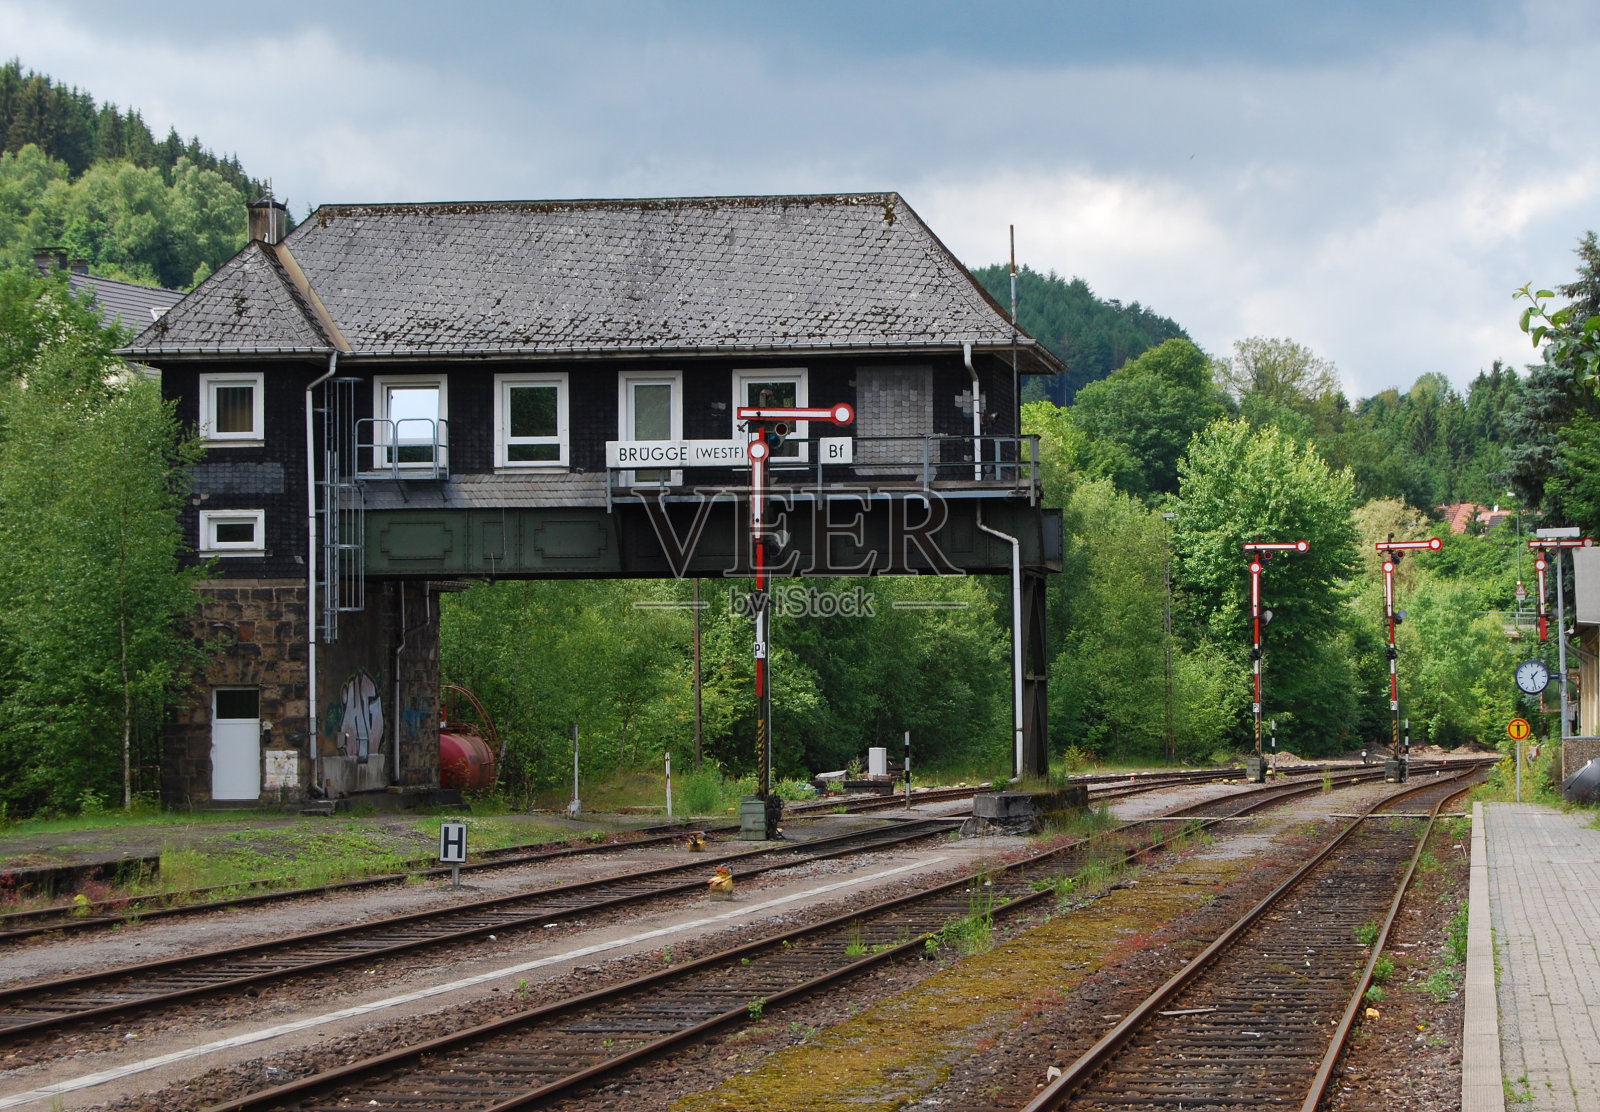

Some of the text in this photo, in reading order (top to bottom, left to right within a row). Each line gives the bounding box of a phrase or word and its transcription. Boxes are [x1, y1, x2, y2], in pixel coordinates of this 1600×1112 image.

[618, 446, 688, 462] BRÜGGE
[828, 444, 844, 458] Bf
[443, 826, 464, 859] H
